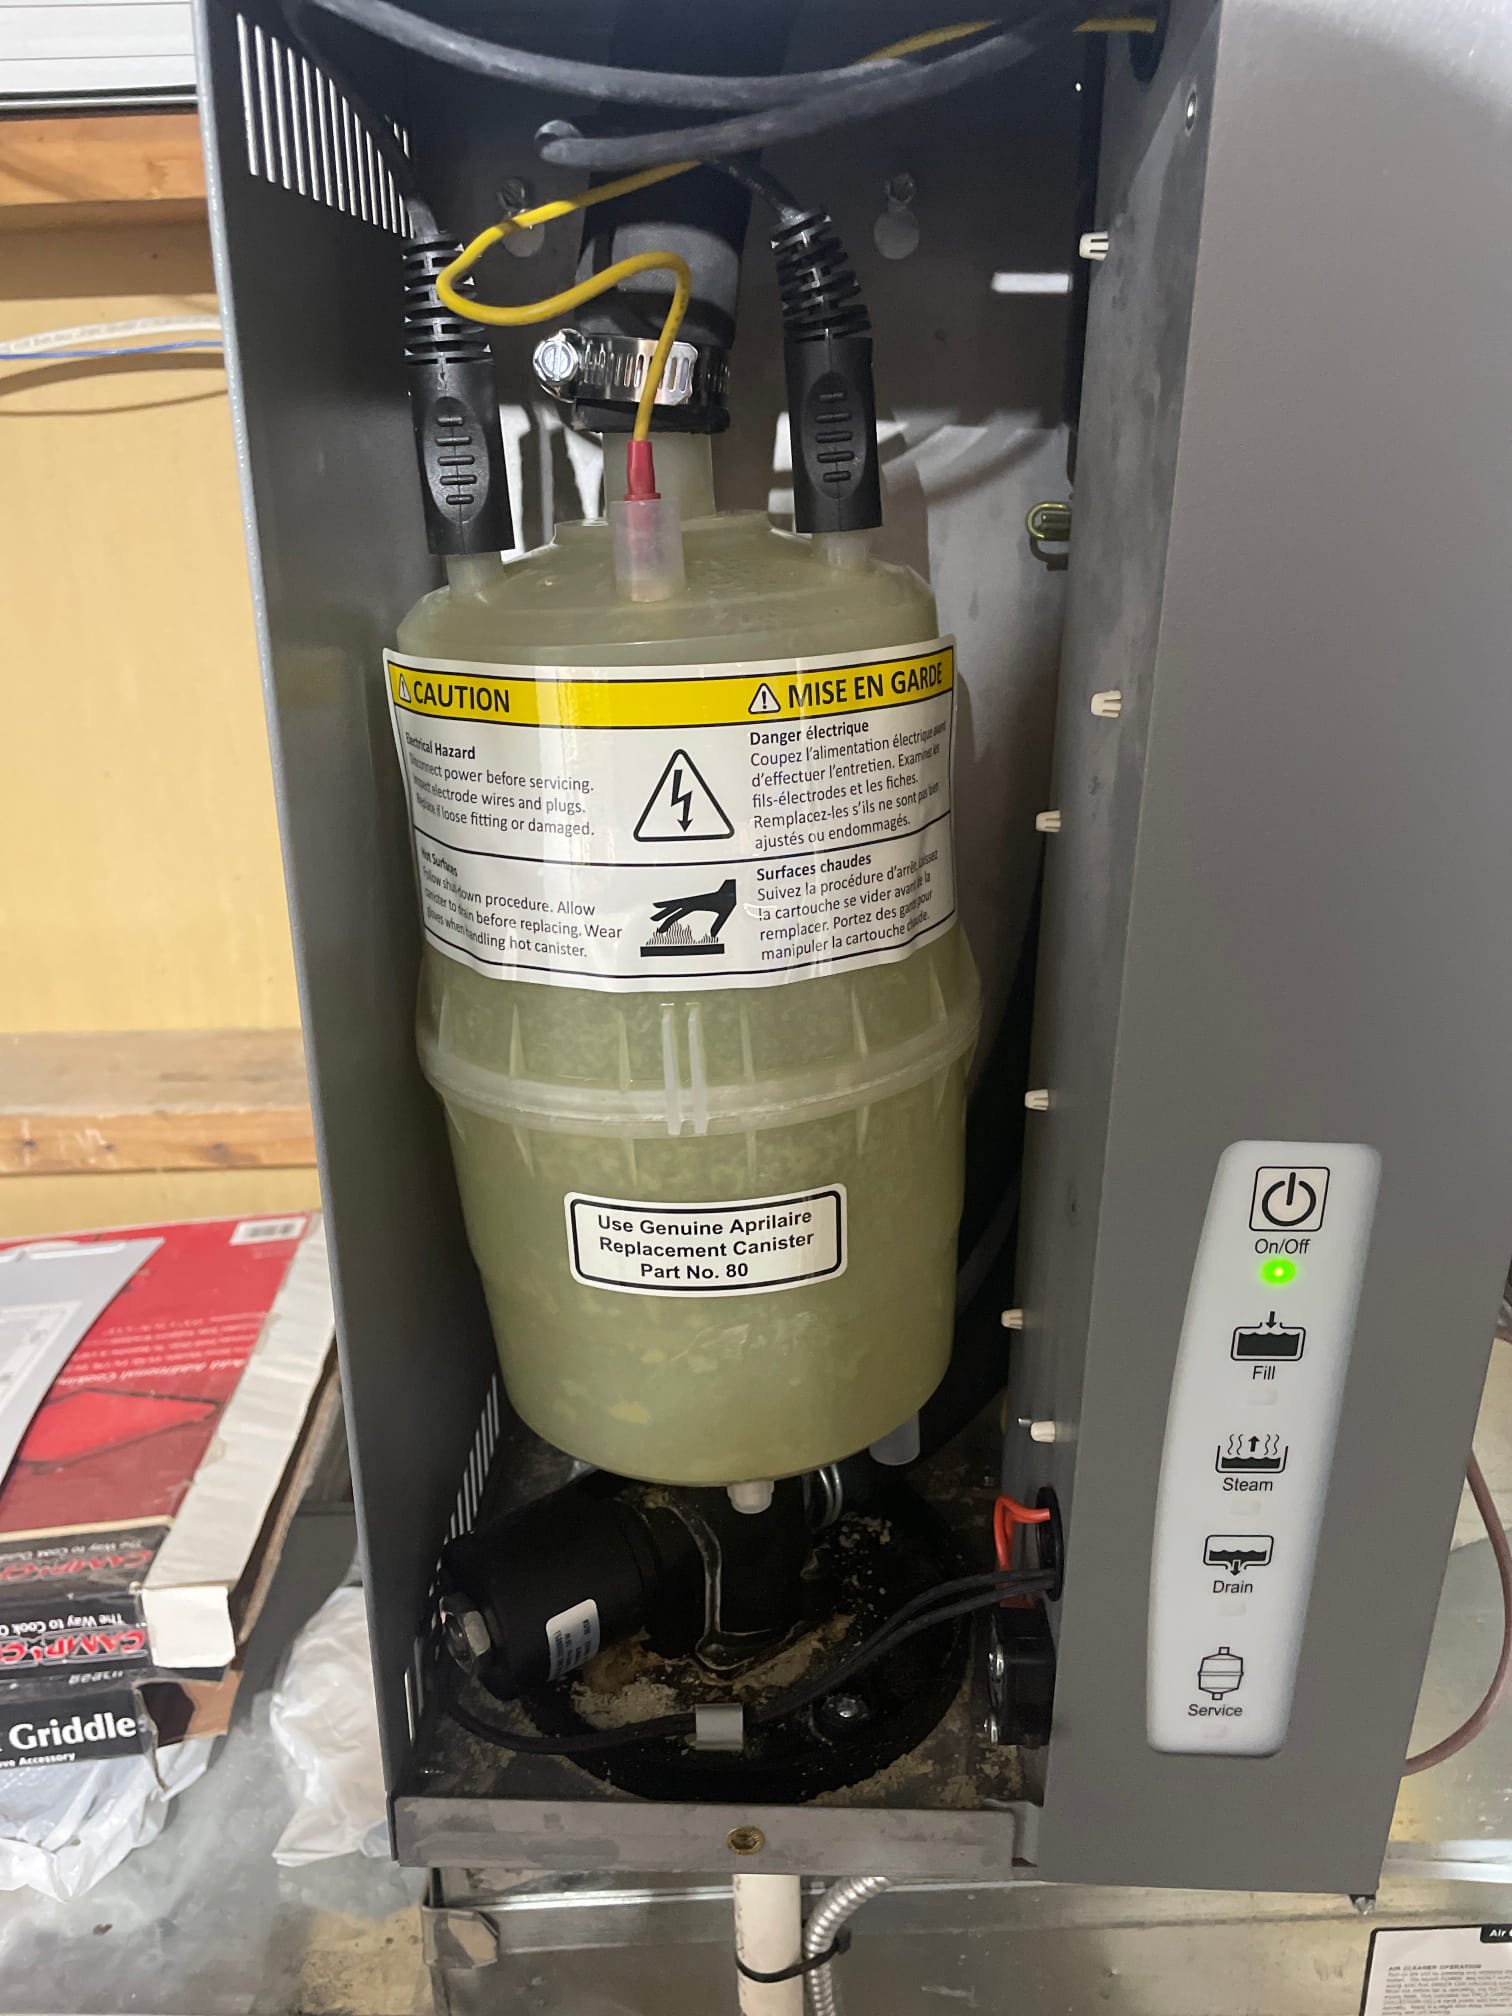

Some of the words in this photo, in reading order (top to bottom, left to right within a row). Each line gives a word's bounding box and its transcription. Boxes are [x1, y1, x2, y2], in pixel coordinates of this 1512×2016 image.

[414, 681, 510, 713] CAUTION
[788, 679, 847, 708] MISE
[854, 674, 883, 700] EN
[891, 662, 942, 694] GARDE
[750, 731, 801, 746] Danger
[806, 721, 869, 740] électrique
[435, 743, 475, 759] Hazard
[751, 752, 802, 767] Coupez
[893, 728, 932, 748] électrique
[445, 768, 483, 782] power
[487, 770, 526, 787] before
[529, 776, 594, 793] servicing.
[752, 785, 846, 808] fils-électrodes
[850, 783, 863, 795] et
[866, 780, 883, 793] les
[887, 773, 918, 790] fiches.
[432, 784, 477, 803] electrode
[482, 793, 515, 807] wires
[518, 796, 541, 810] and
[546, 798, 586, 815] plugs.
[754, 805, 849, 829] Remplacez-les
[878, 799, 893, 811] ne
[896, 793, 916, 808] sont
[442, 806, 467, 823] loose
[471, 812, 507, 832] fitting
[511, 819, 524, 830] or
[528, 818, 594, 837] damaged.
[755, 832, 805, 852] ajustés
[808, 831, 825, 843] ou
[828, 813, 910, 840] endommagés.
[756, 865, 816, 881] Surfaces
[820, 853, 871, 873] chaudes
[757, 886, 801, 901] Suivez
[805, 882, 816, 895] la
[820, 872, 883, 896] procédure
[775, 899, 840, 919] cartouche
[844, 896, 857, 908] se
[860, 889, 892, 904] vider
[924, 871, 931, 883] la
[485, 894, 553, 912] procedure.
[557, 901, 595, 916] Allow
[448, 900, 456, 912] to
[476, 911, 517, 928] before
[520, 919, 582, 939] replacing.
[584, 924, 623, 938] Wear
[760, 921, 829, 941] remplacer.
[833, 912, 872, 929] Portez
[875, 907, 897, 921] des
[510, 936, 531, 951] hot
[534, 942, 587, 958] canister.
[761, 939, 829, 961] manipuler
[832, 936, 842, 949] la
[846, 923, 905, 945] cartouche
[597, 1214, 633, 1232] Use
[640, 1220, 723, 1236] Genuine
[729, 1210, 812, 1236] Aprilaire
[600, 1237, 727, 1258] Replacement
[733, 1230, 815, 1256] Canister
[1255, 1238, 1311, 1255] On/Off
[640, 1263, 680, 1279] Part
[686, 1264, 720, 1279] No.
[726, 1262, 749, 1278] 80
[1252, 1365, 1276, 1380] Fill
[1222, 1477, 1273, 1492] Steam
[1212, 1580, 1254, 1594] Drain
[12, 1621, 46, 1635] Cook
[49, 1618, 64, 1629] to
[67, 1614, 97, 1628] Way
[99, 1613, 124, 1625] The
[1188, 1703, 1243, 1717] Service
[8, 1711, 137, 1750] Griddle
[18, 1752, 76, 1767] Accessory
[1489, 1929, 1506, 1937] Air
